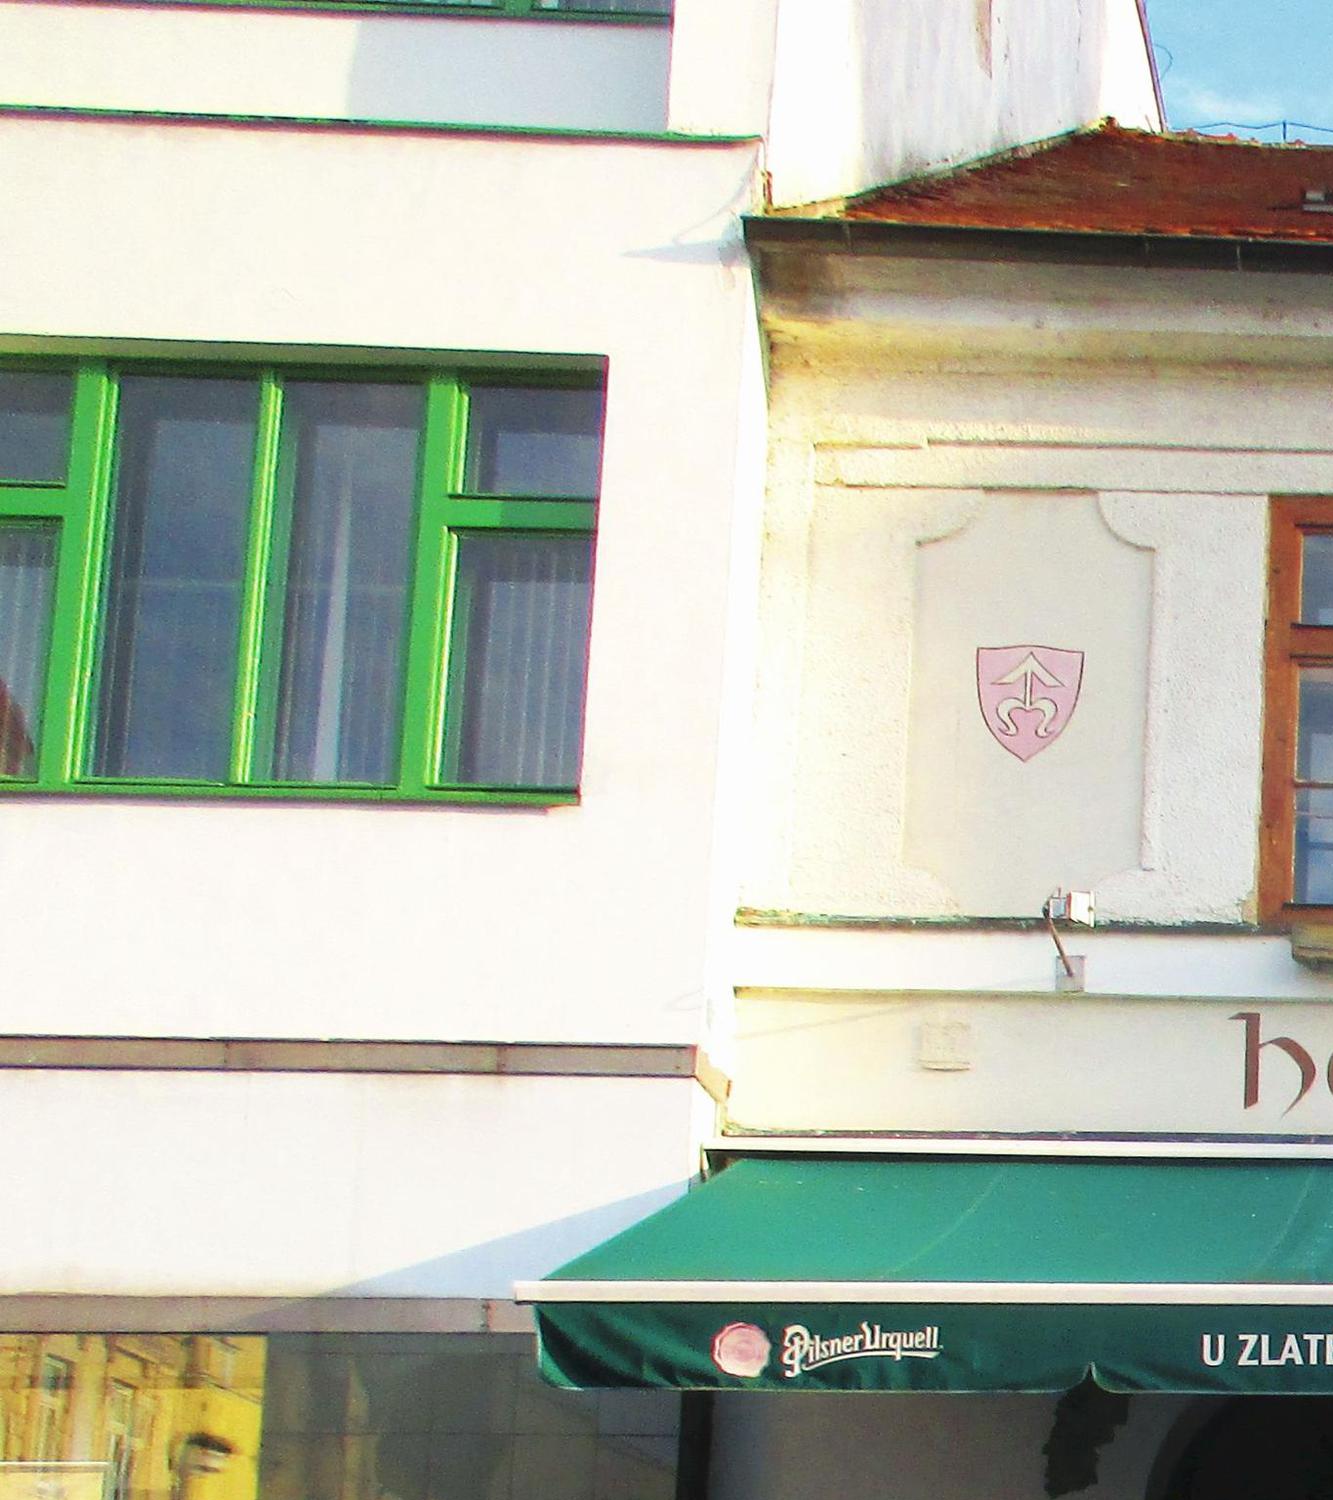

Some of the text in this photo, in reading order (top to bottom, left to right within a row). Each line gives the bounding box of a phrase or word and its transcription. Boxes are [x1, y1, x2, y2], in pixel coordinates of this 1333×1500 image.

[783, 1323, 939, 1377] Pilsner Urquell
[1203, 1335, 1226, 1366] U
